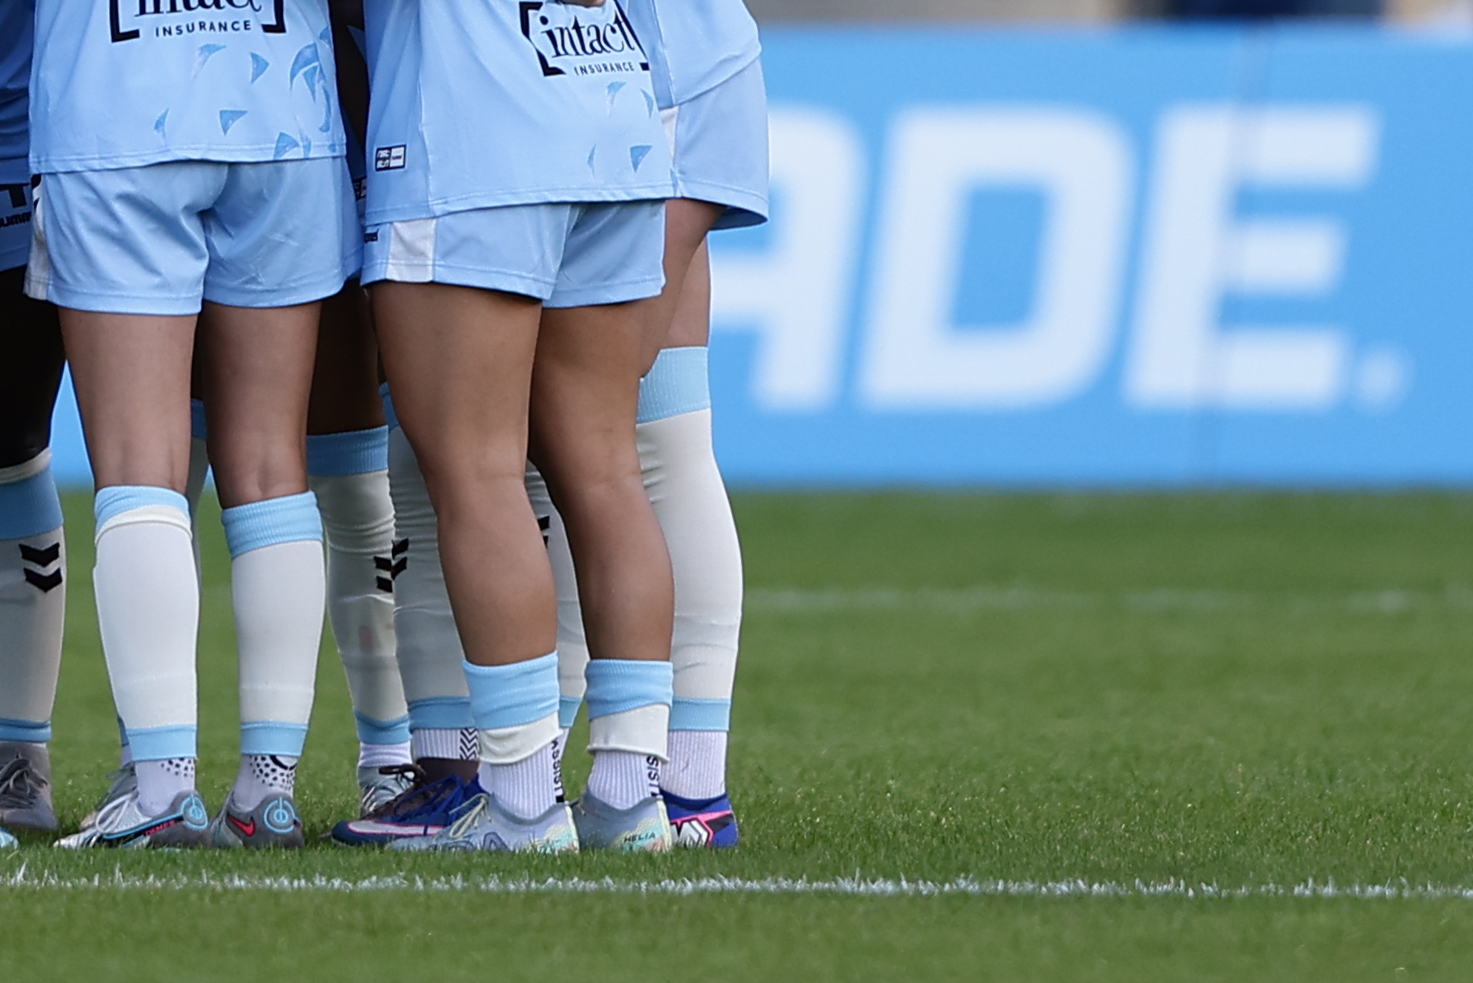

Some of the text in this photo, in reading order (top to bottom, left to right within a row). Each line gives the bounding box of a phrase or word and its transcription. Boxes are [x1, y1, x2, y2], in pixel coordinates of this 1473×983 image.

[155, 20, 252, 37] INSURANCE
[539, 9, 635, 58] intact
[573, 61, 635, 76] INSURANCE
[624, 831, 657, 843] HELIA
